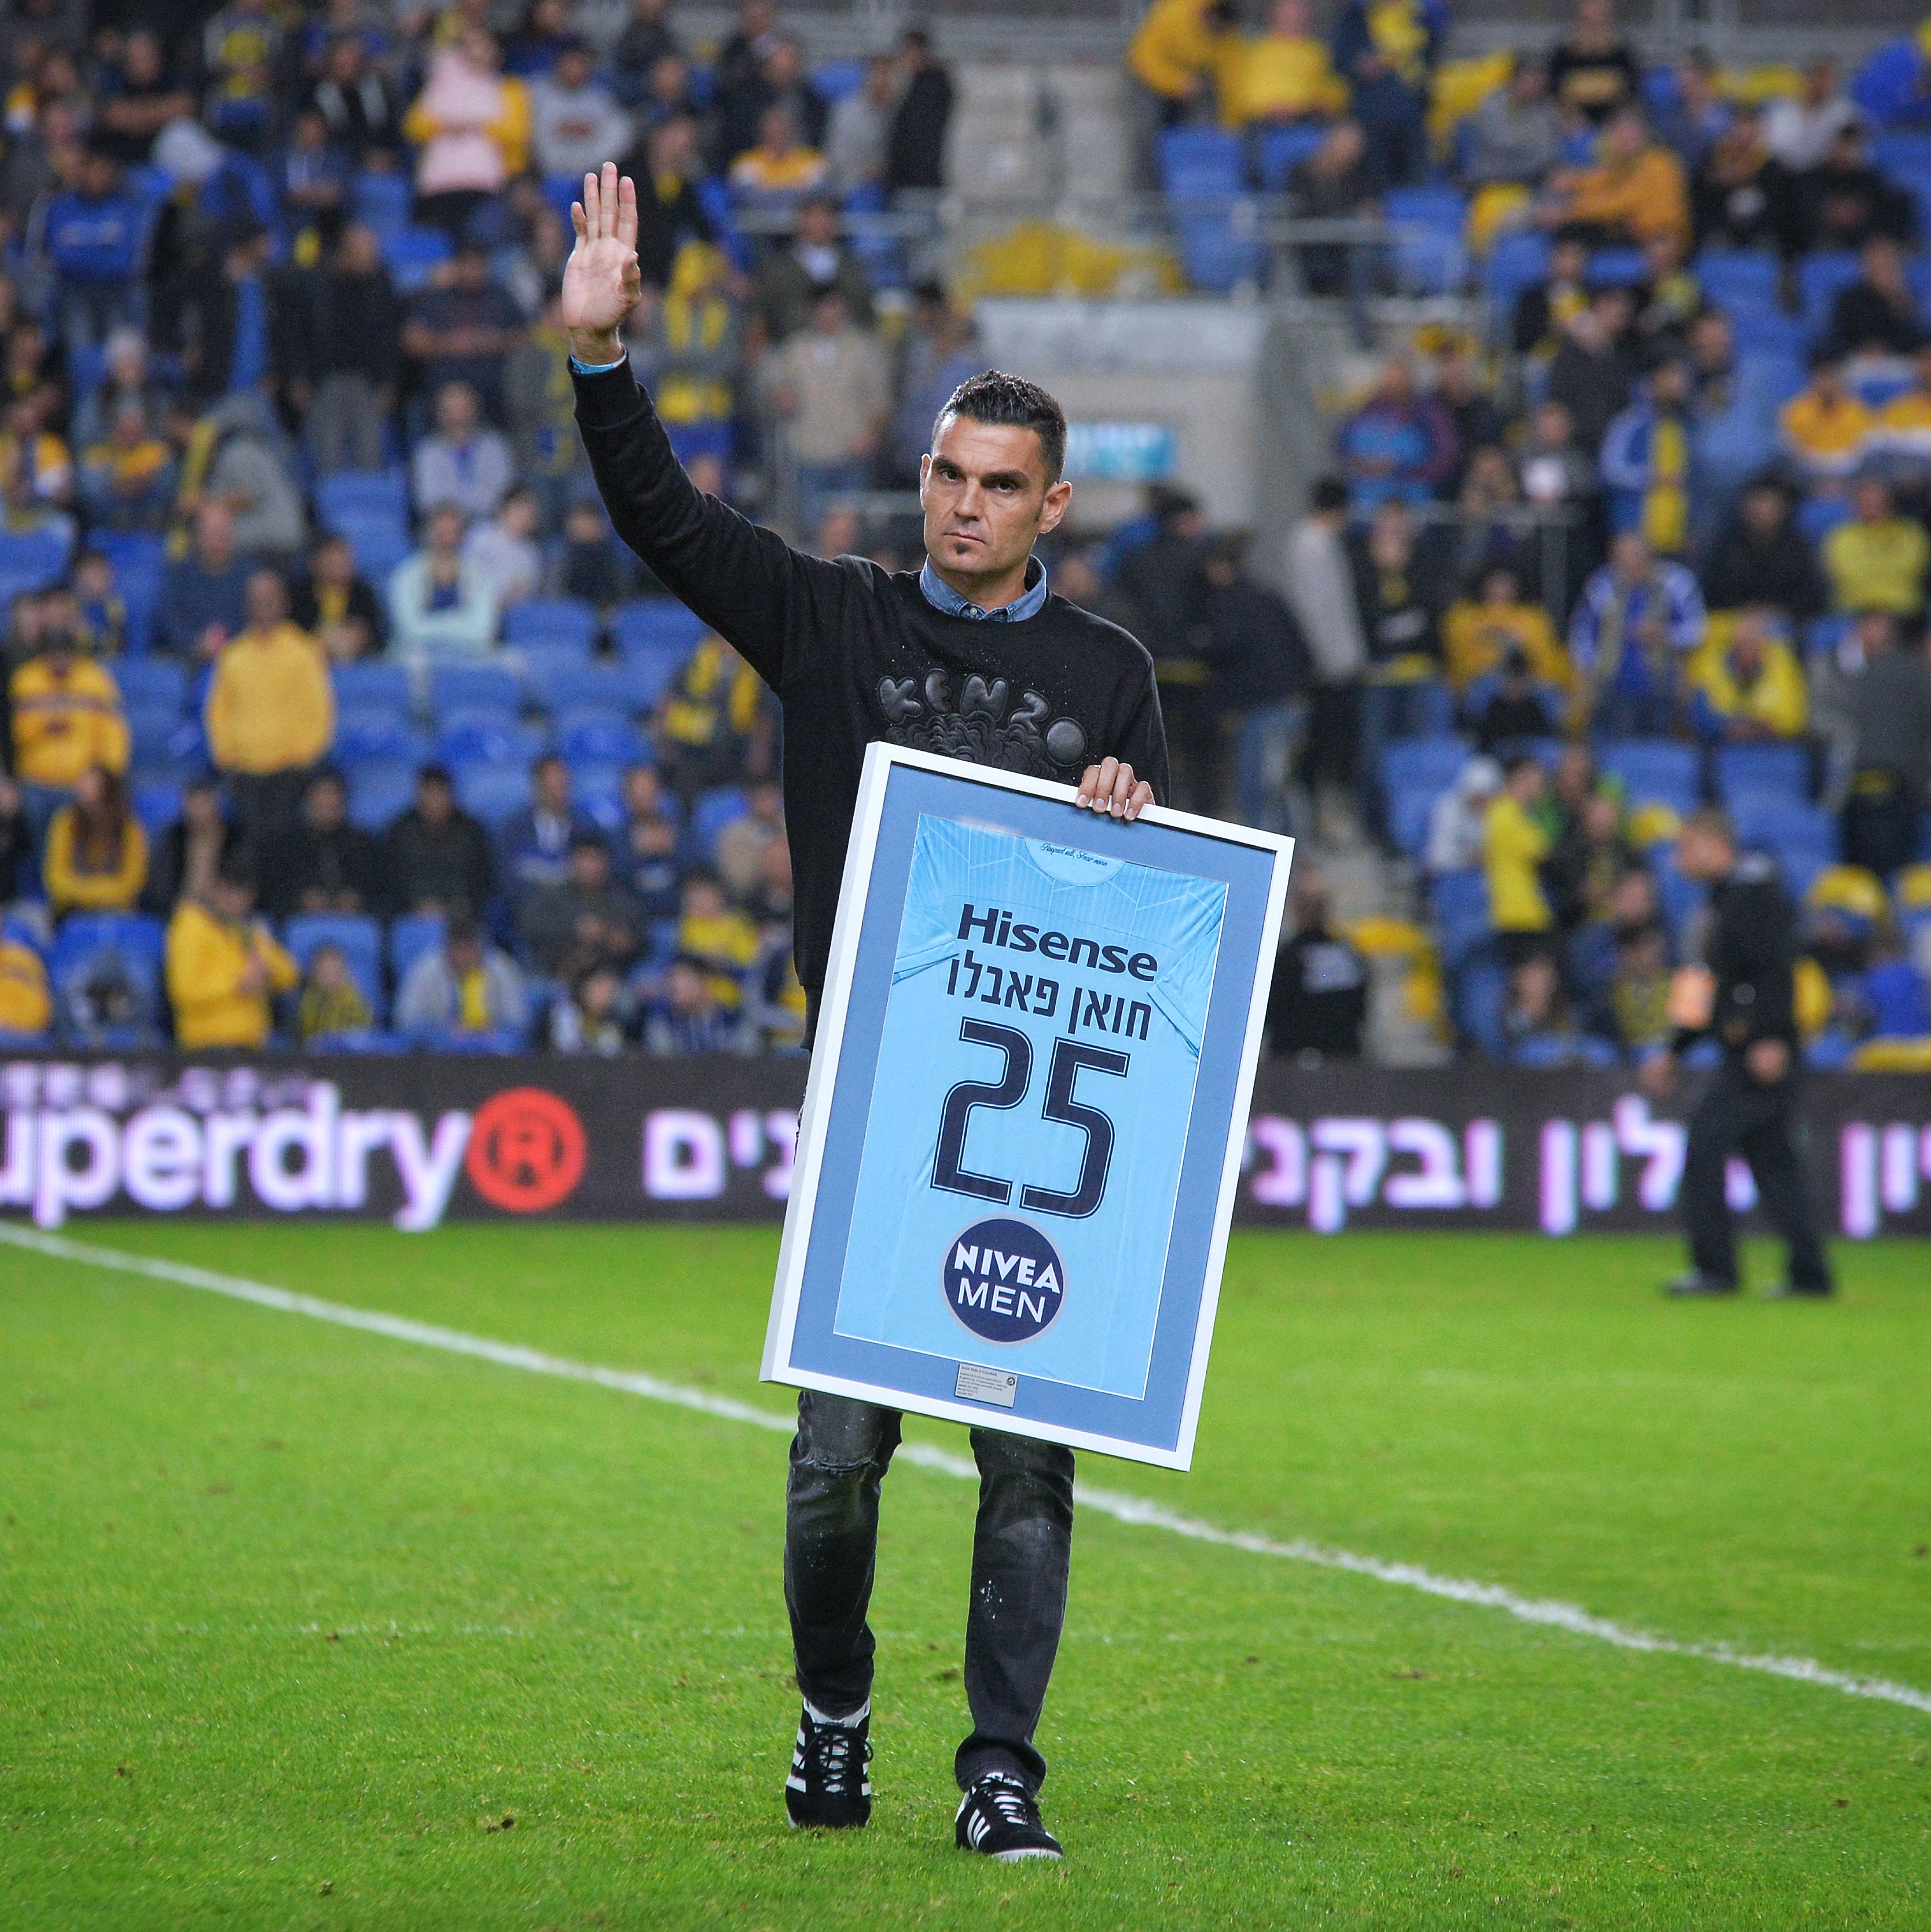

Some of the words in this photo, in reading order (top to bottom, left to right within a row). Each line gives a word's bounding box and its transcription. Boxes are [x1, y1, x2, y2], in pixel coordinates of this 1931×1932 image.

[957, 903, 1158, 982] Hisense
[947, 949, 1059, 1018] פאבלו
[1067, 987, 1151, 1041] חואן
[930, 1016, 1131, 1219] 25
[1241, 1116, 1502, 1234] ובקנ
[955, 1241, 1060, 1294] NIVEA
[957, 1277, 1045, 1324] MEN
